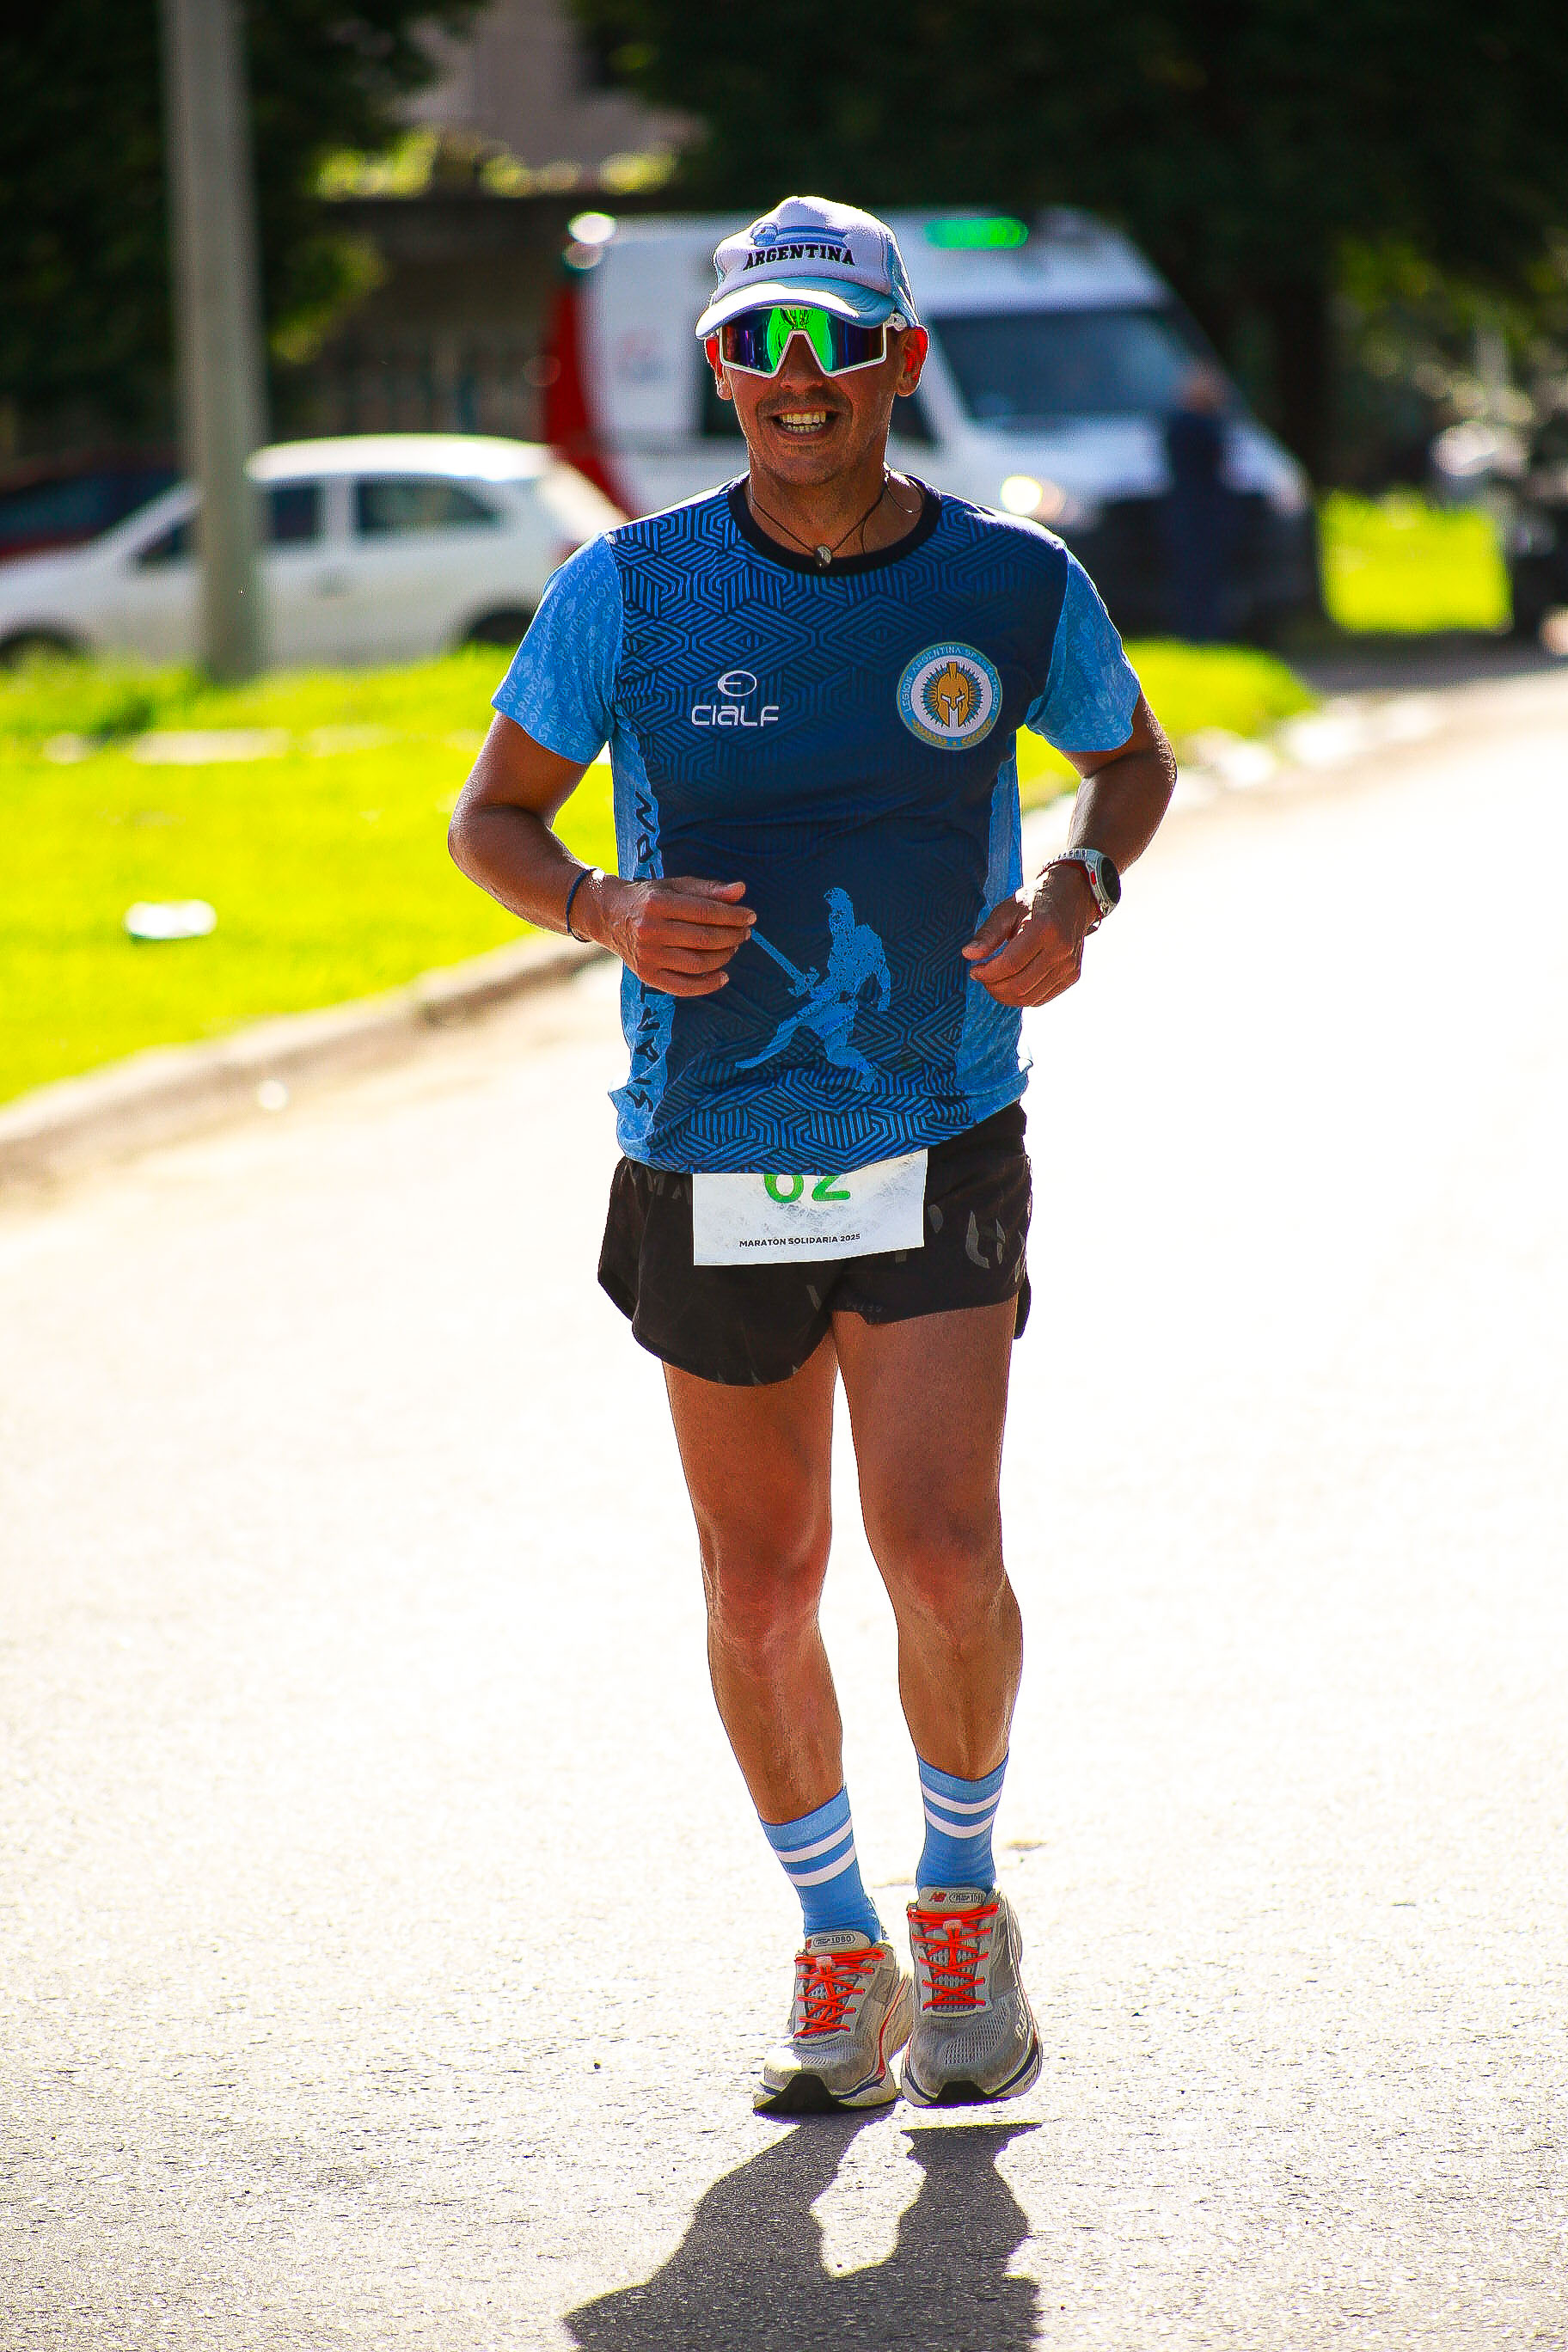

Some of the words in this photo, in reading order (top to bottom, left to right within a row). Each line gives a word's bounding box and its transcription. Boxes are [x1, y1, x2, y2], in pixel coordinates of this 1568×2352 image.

[743, 244, 855, 271] ARGENTINA
[788, 1235, 838, 1245] SOLIDARIA
[840, 1233, 861, 1241] 2025
